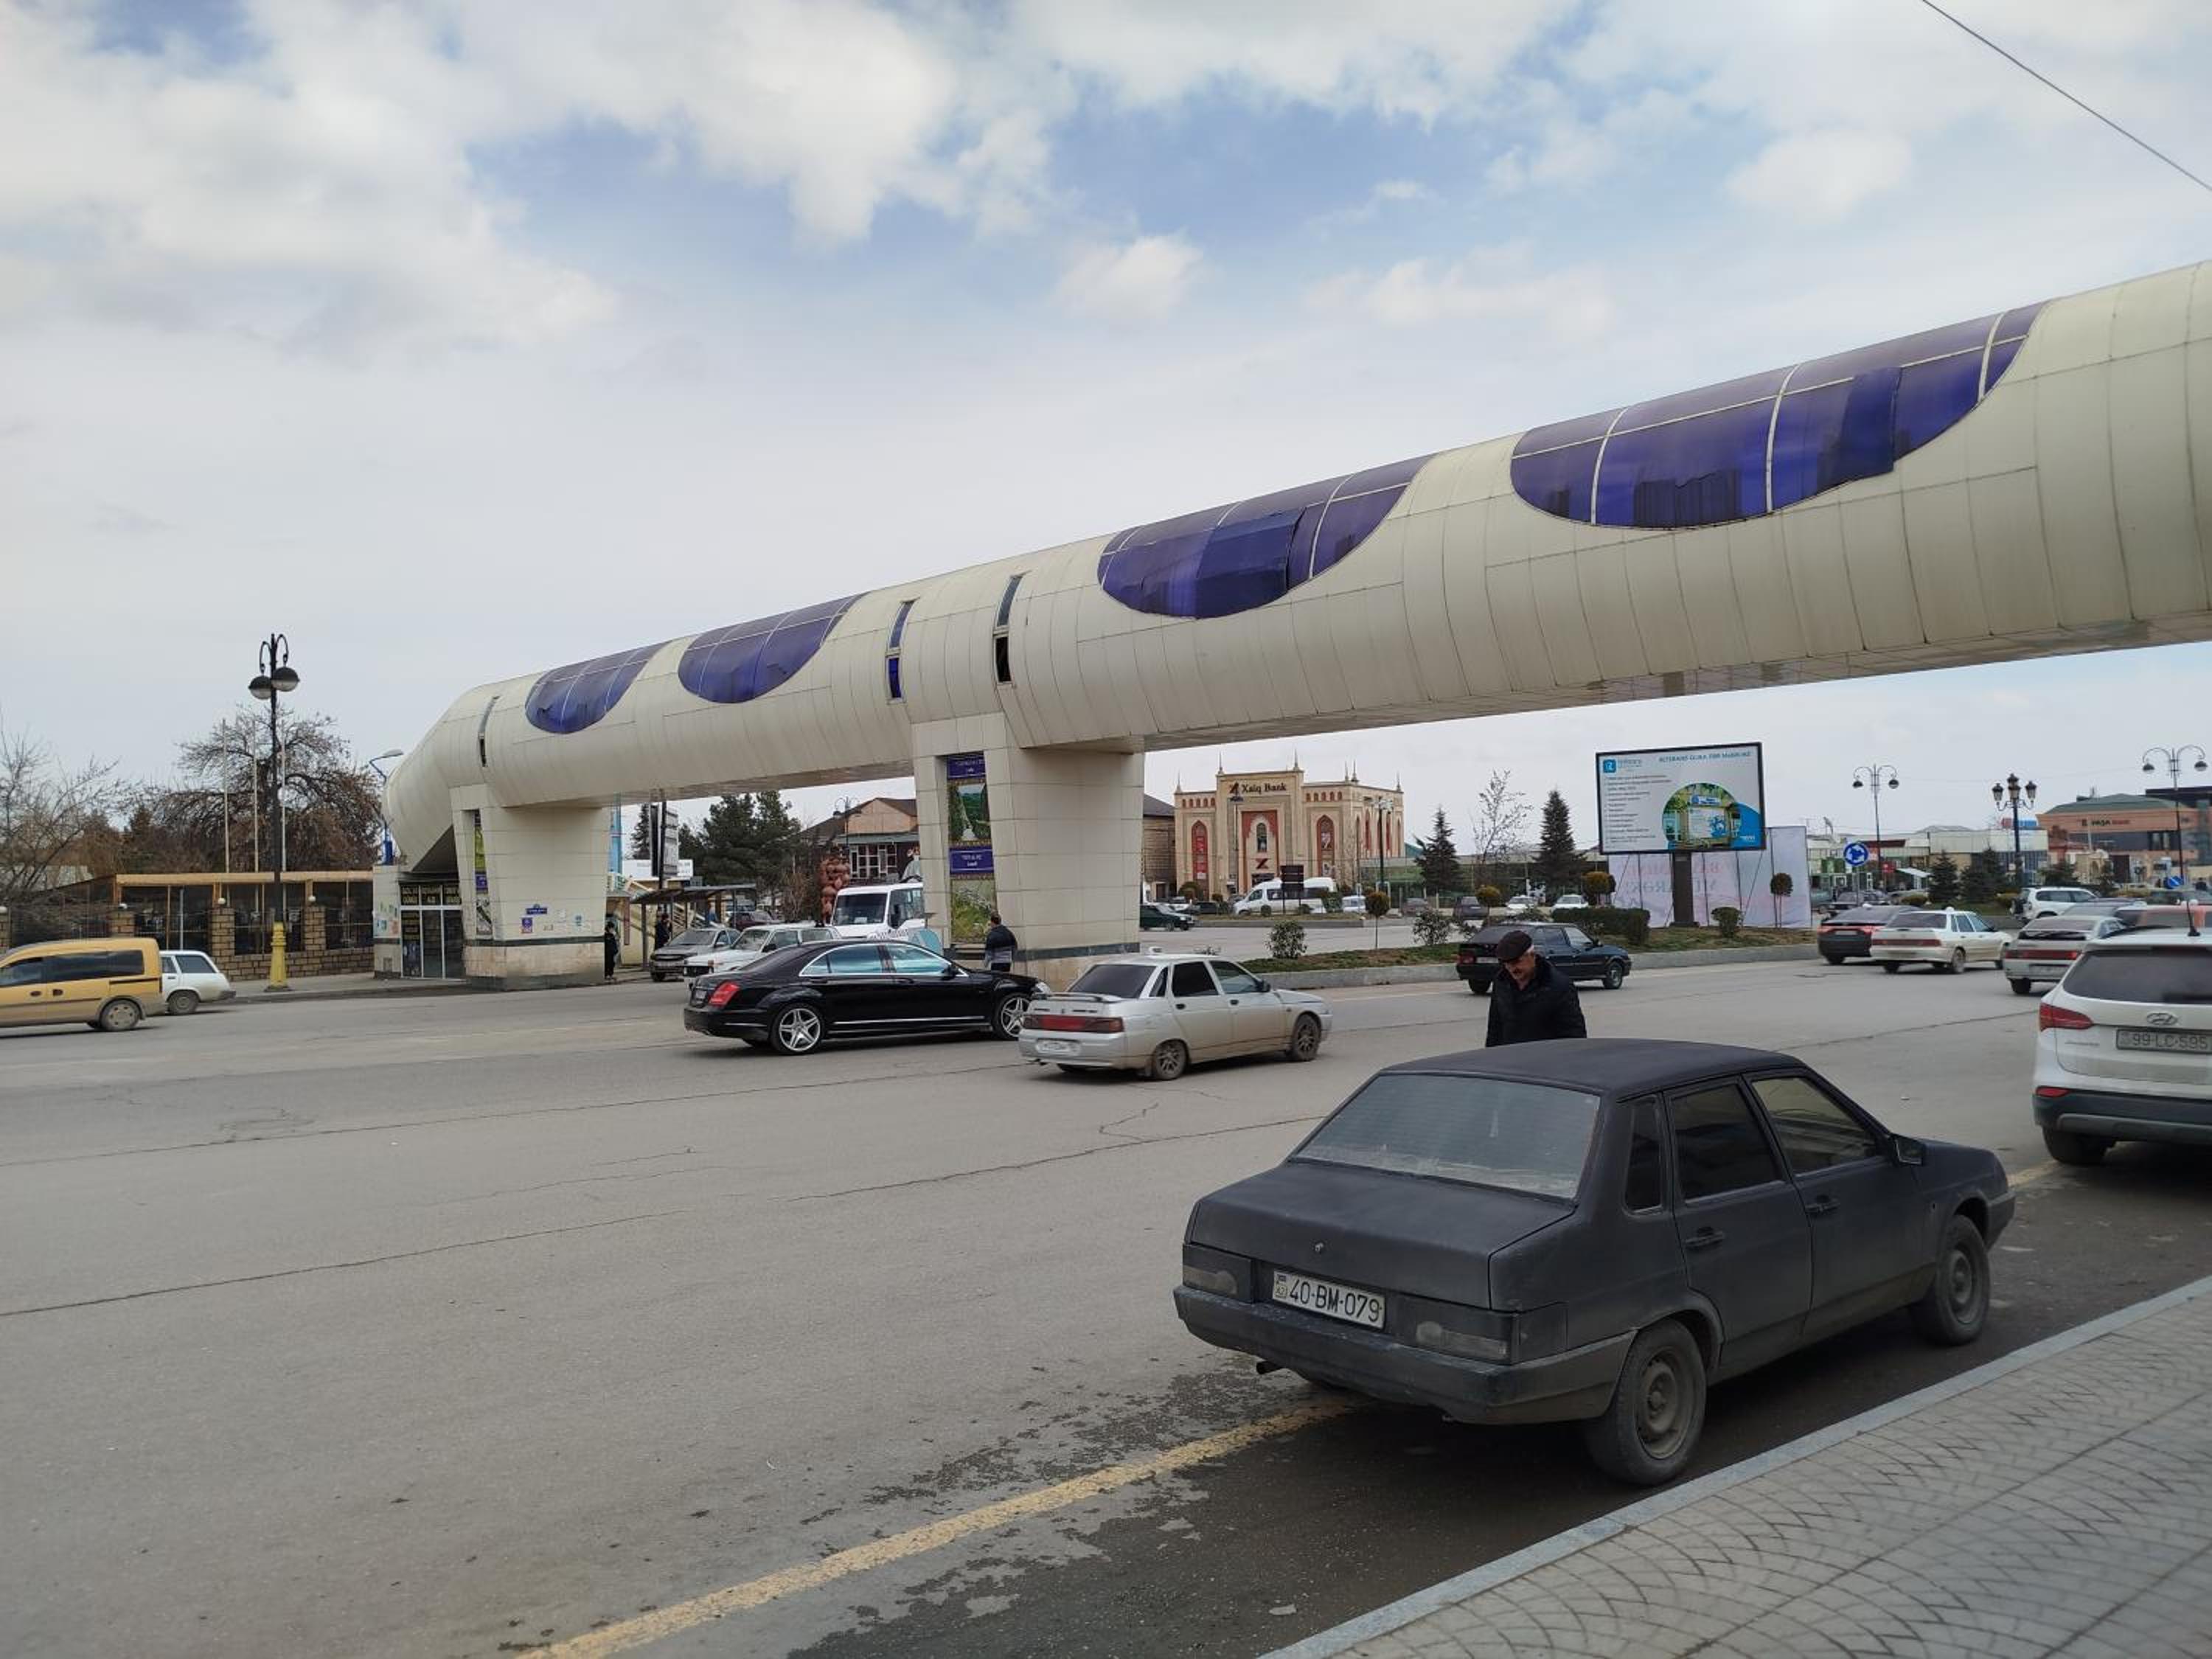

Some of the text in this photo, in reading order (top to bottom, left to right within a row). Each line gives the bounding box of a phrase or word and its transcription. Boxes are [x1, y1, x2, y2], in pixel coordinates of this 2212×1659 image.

[1241, 782, 1286, 795] Xalq Bank
[1290, 1279, 1380, 1322] 40-BM-079
